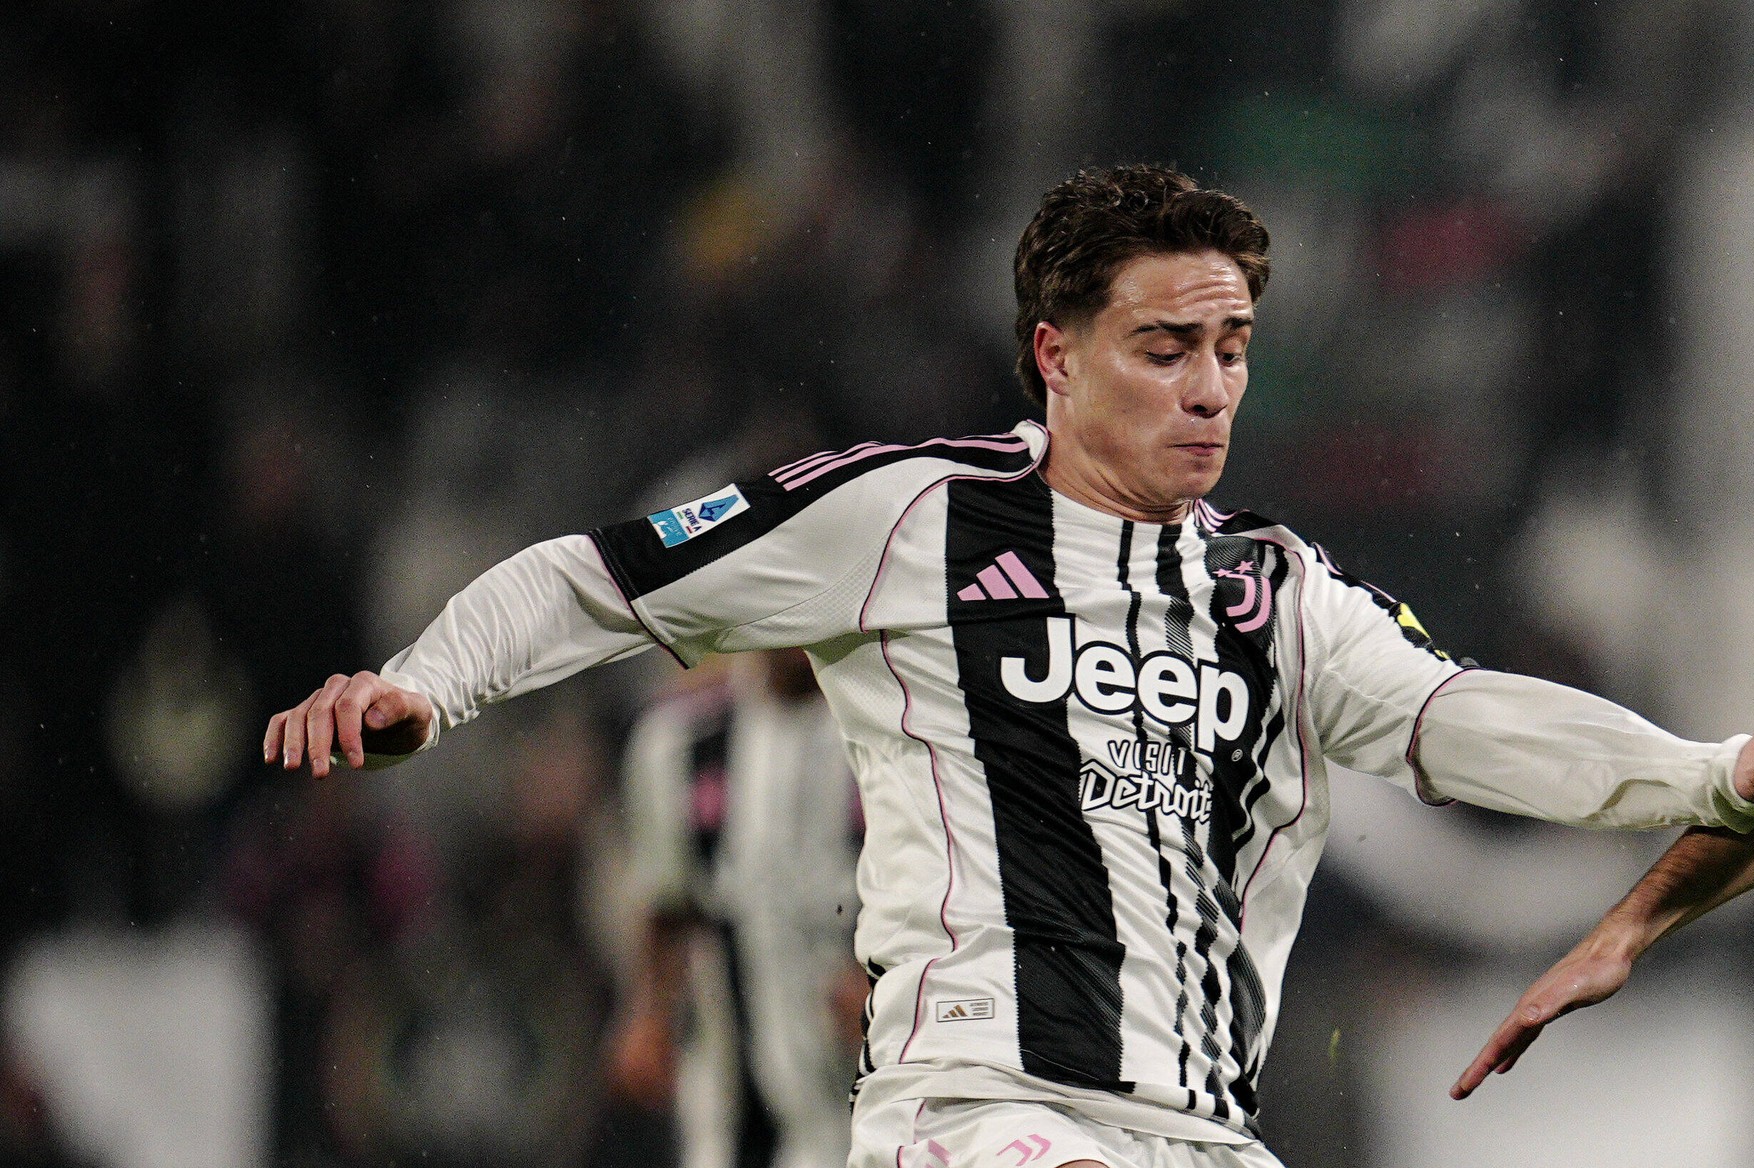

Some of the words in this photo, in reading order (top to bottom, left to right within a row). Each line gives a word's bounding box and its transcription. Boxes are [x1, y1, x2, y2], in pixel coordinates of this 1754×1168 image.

[682, 507, 700, 526] SERIE
[1001, 616, 1249, 752] Jeep
[1108, 740, 1185, 776] VISIT
[1079, 759, 1212, 824] Detroit
